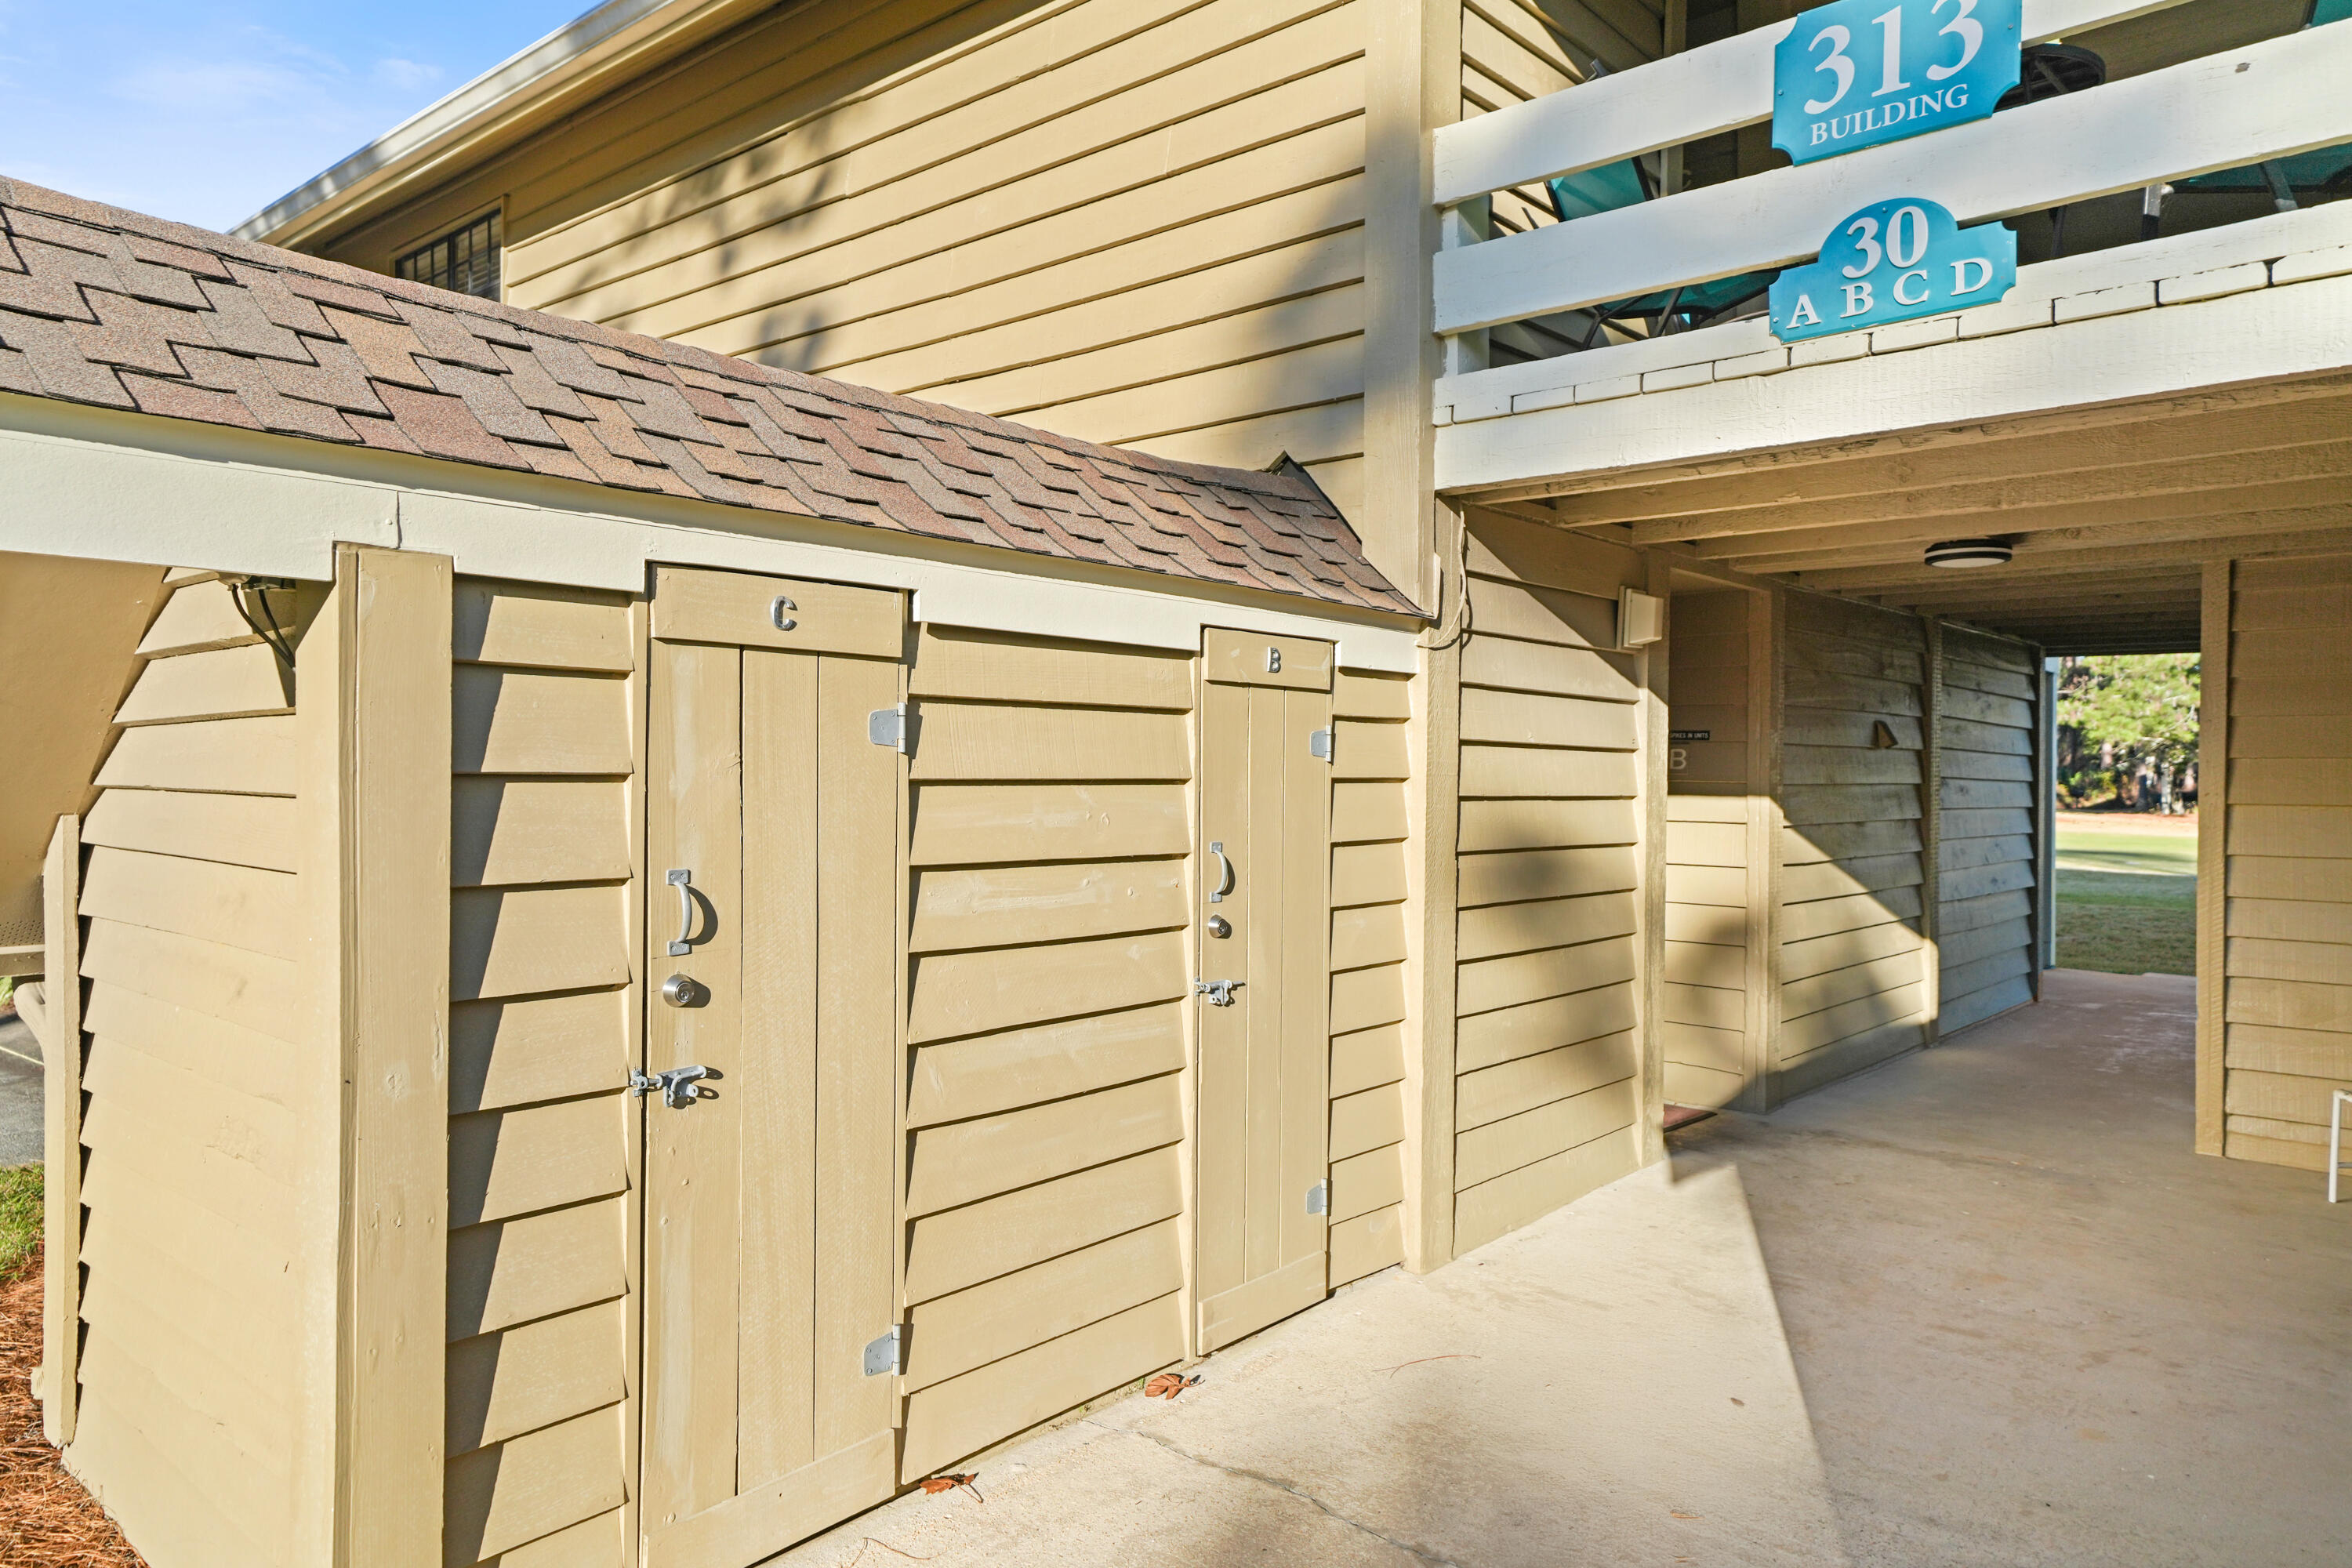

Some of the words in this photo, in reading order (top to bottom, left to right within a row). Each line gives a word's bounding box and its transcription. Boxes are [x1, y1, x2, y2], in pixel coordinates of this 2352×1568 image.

[1804, 0, 1984, 114] 313
[1809, 83, 1969, 147] BUILDING
[1842, 205, 1929, 279] 30
[1786, 294, 1821, 330] A
[1840, 282, 1874, 318] B
[1893, 270, 1929, 306] C
[1950, 257, 1993, 296] D
[770, 595, 798, 631] C
[1267, 646, 1281, 673] B
[1669, 748, 1687, 770] B
